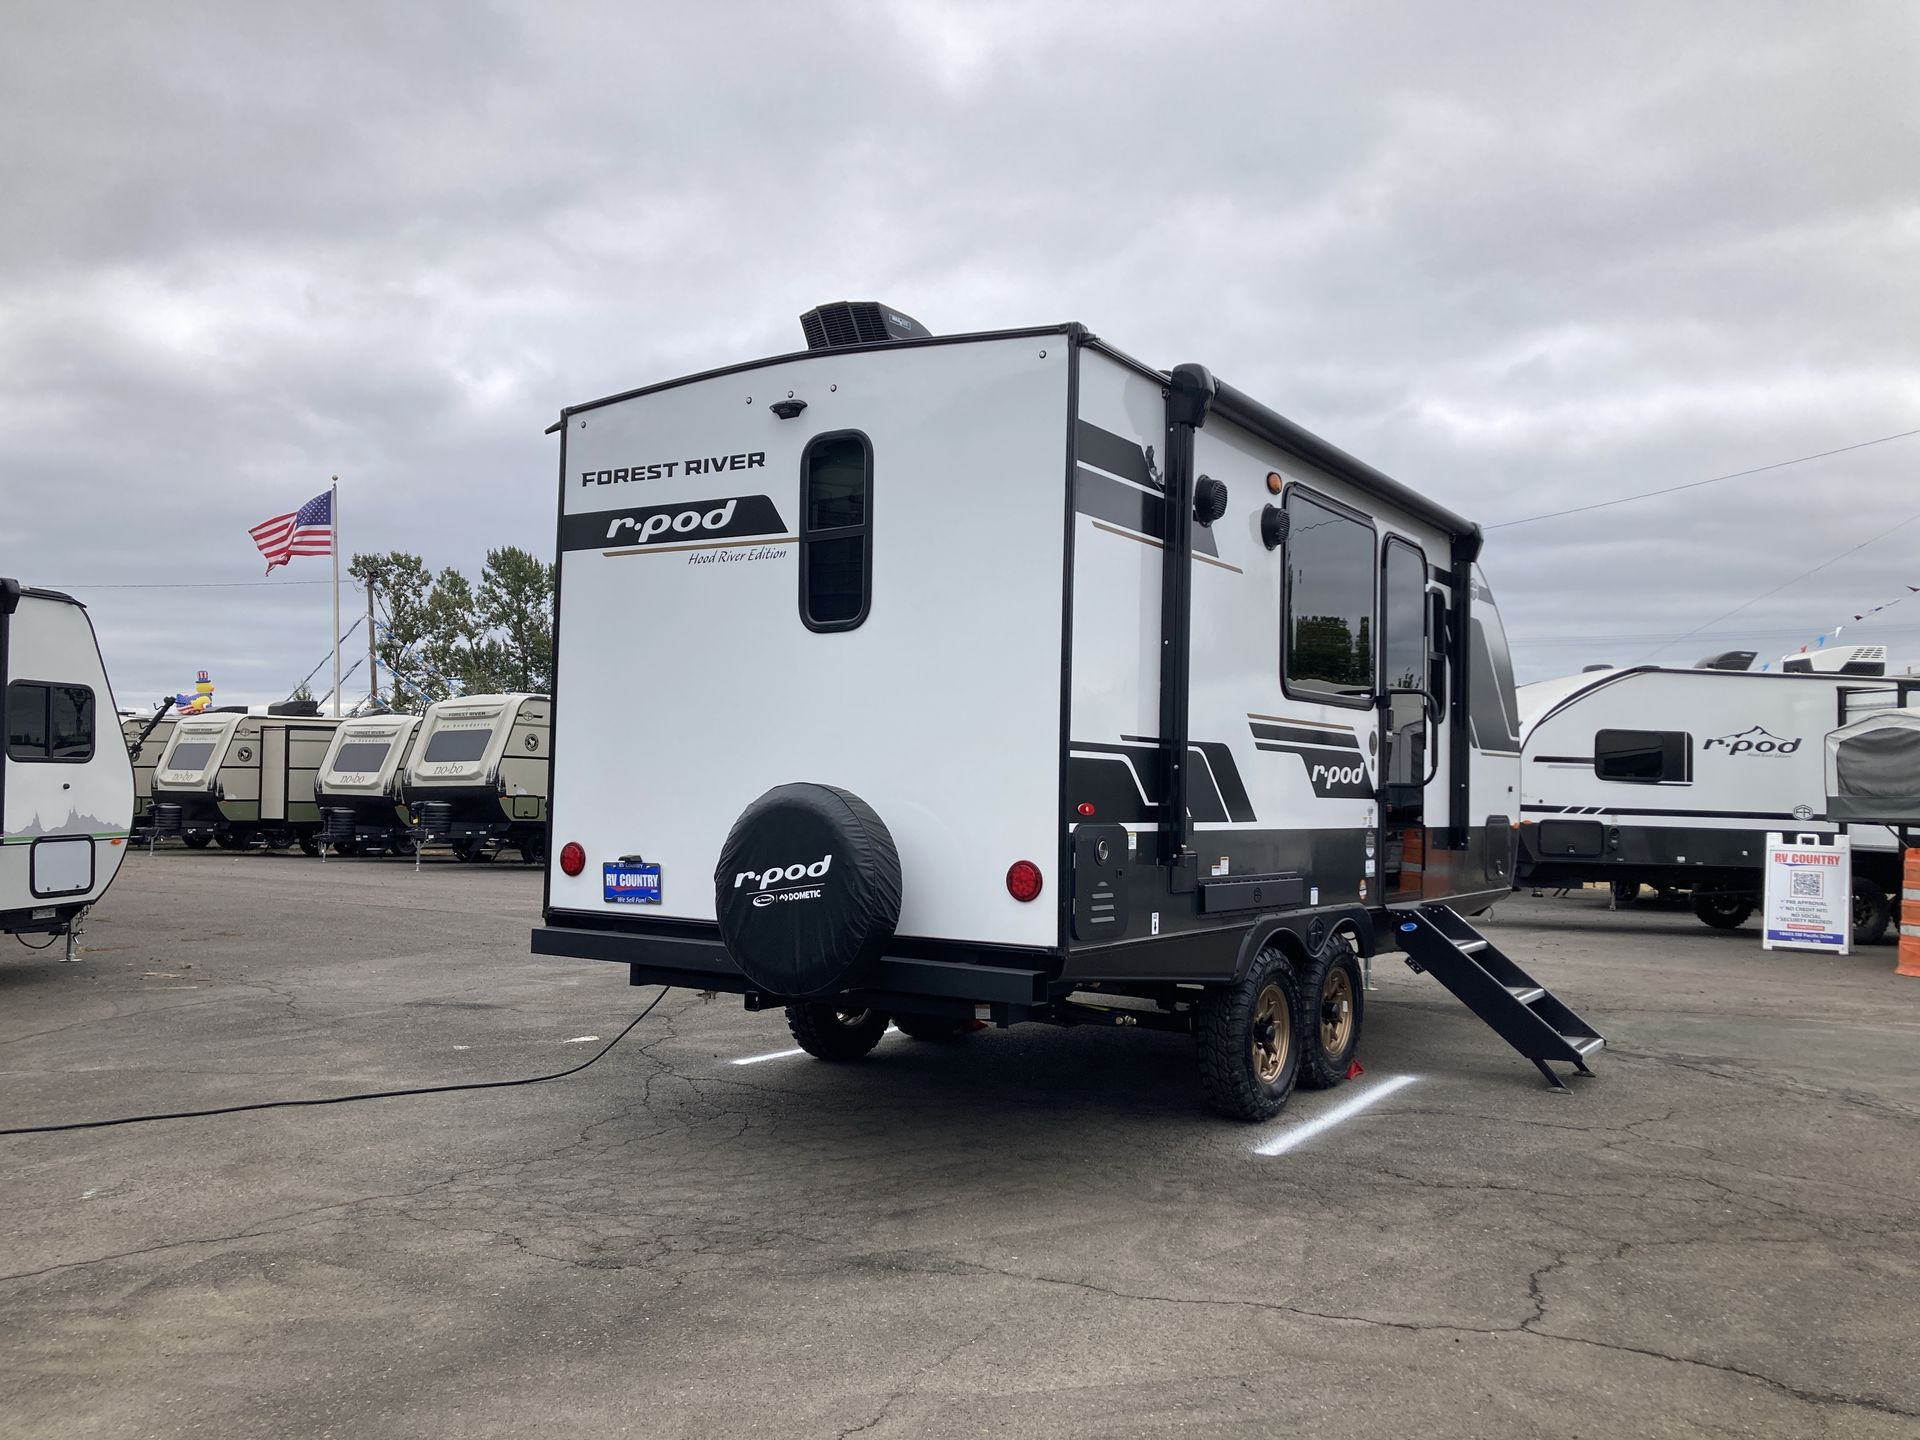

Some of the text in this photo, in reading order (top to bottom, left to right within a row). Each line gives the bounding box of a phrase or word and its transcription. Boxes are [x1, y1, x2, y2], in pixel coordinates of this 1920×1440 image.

[581, 452, 766, 488] FOREST RIVER
[688, 546, 787, 565] Hood River Edition
[1775, 853, 1840, 865] RV COUNTRY
[606, 873, 658, 887] RV COUNTRY
[625, 896, 636, 904] Sell
[788, 889, 822, 901] DOMETIC
